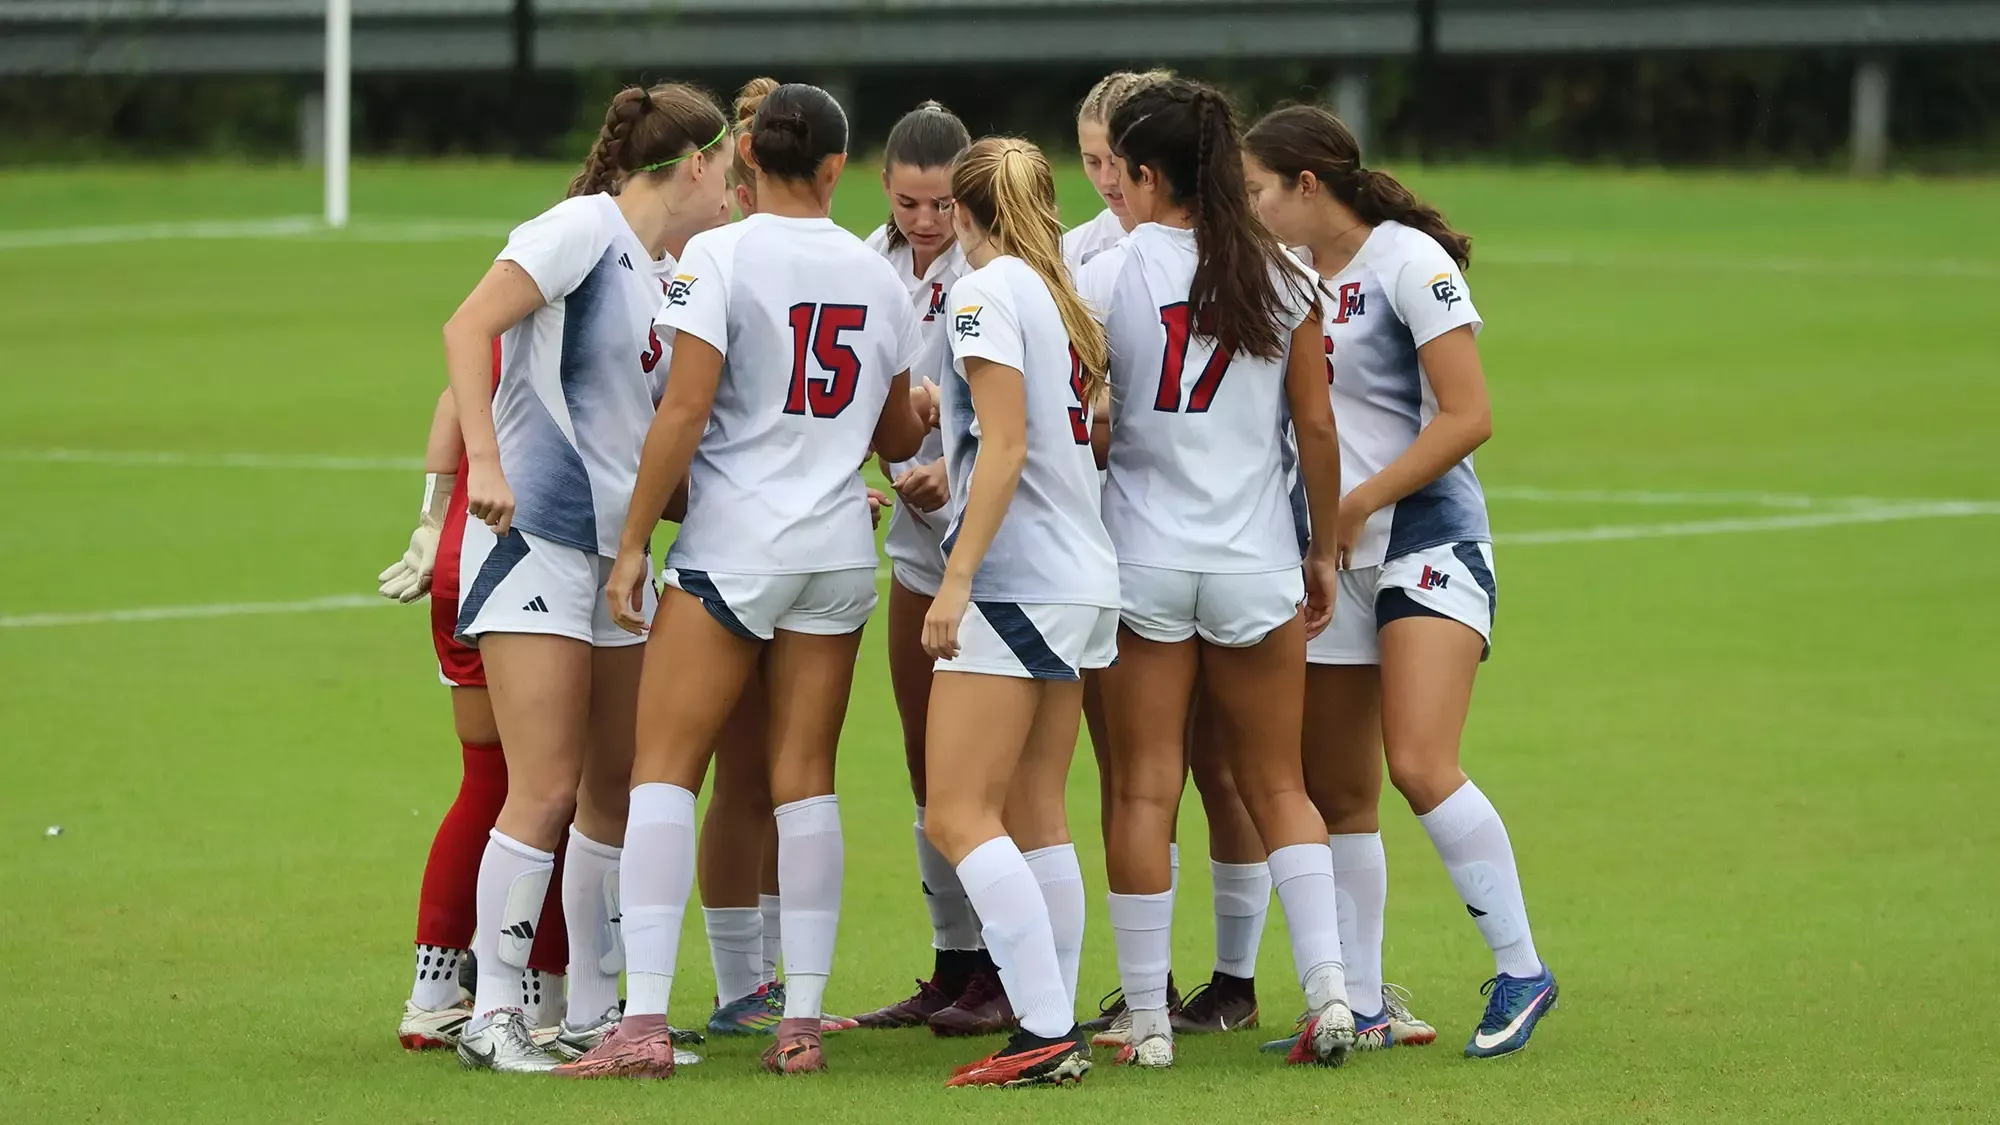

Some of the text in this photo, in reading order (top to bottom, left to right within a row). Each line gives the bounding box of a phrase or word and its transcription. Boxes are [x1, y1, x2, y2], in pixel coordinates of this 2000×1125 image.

[1153, 301, 1240, 413] 17
[1332, 282, 1366, 324] FM
[783, 302, 869, 419] 15
